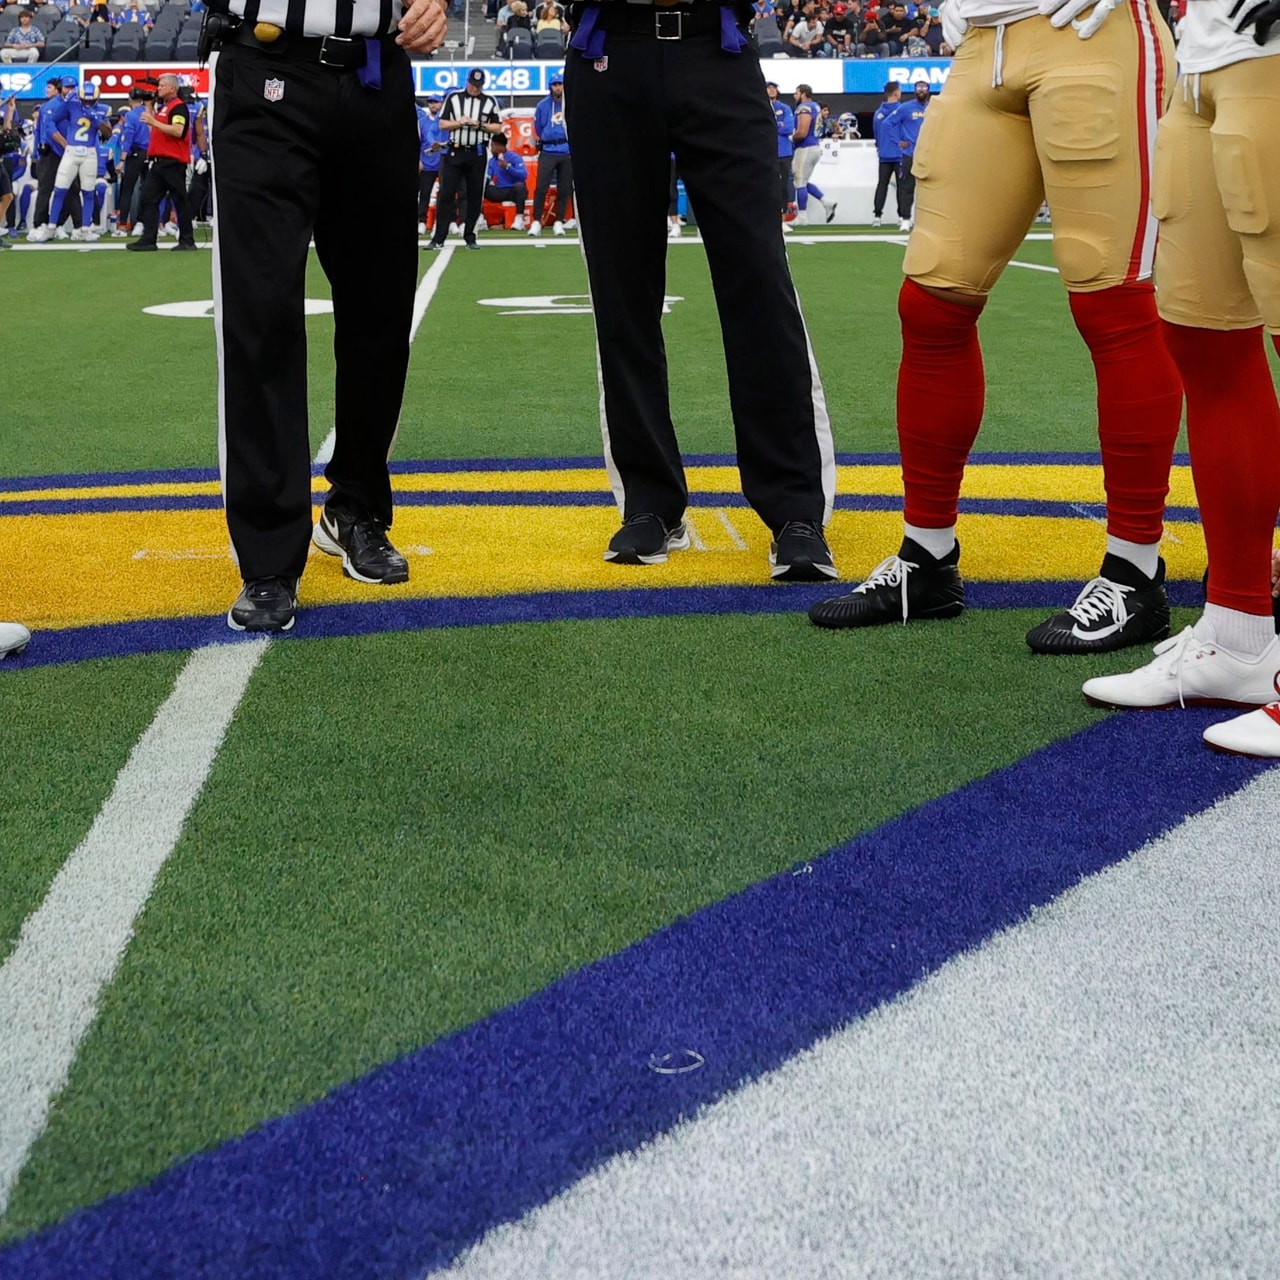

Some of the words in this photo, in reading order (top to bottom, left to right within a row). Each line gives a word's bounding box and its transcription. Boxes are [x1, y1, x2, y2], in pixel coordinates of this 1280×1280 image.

[888, 66, 950, 84] RAM
[74, 117, 91, 142] 2
[519, 122, 532, 137] G
